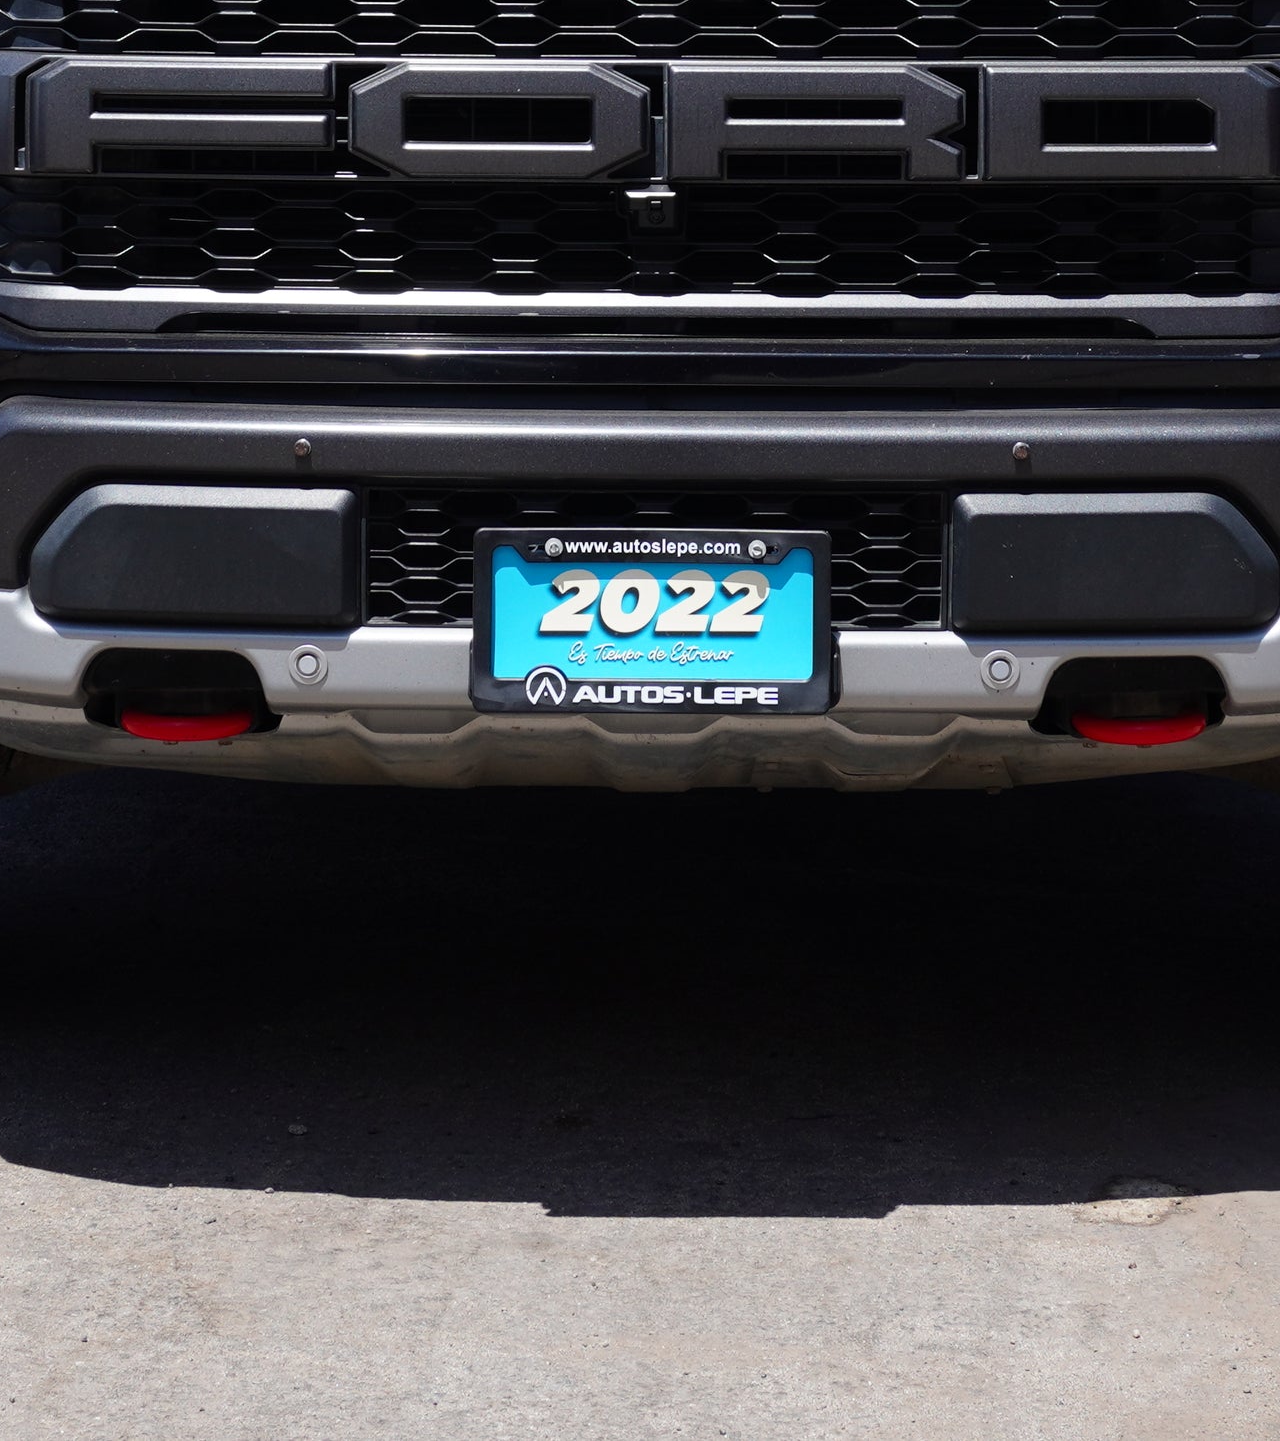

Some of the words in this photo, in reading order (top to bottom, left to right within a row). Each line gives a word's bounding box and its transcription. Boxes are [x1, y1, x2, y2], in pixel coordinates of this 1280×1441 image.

[565, 538, 741, 556] www.autoslepe.com
[538, 568, 771, 635] 2022
[569, 640, 588, 665] Es
[594, 642, 644, 664] Tiempo
[646, 646, 667, 662] de
[669, 641, 735, 665] Estrenar
